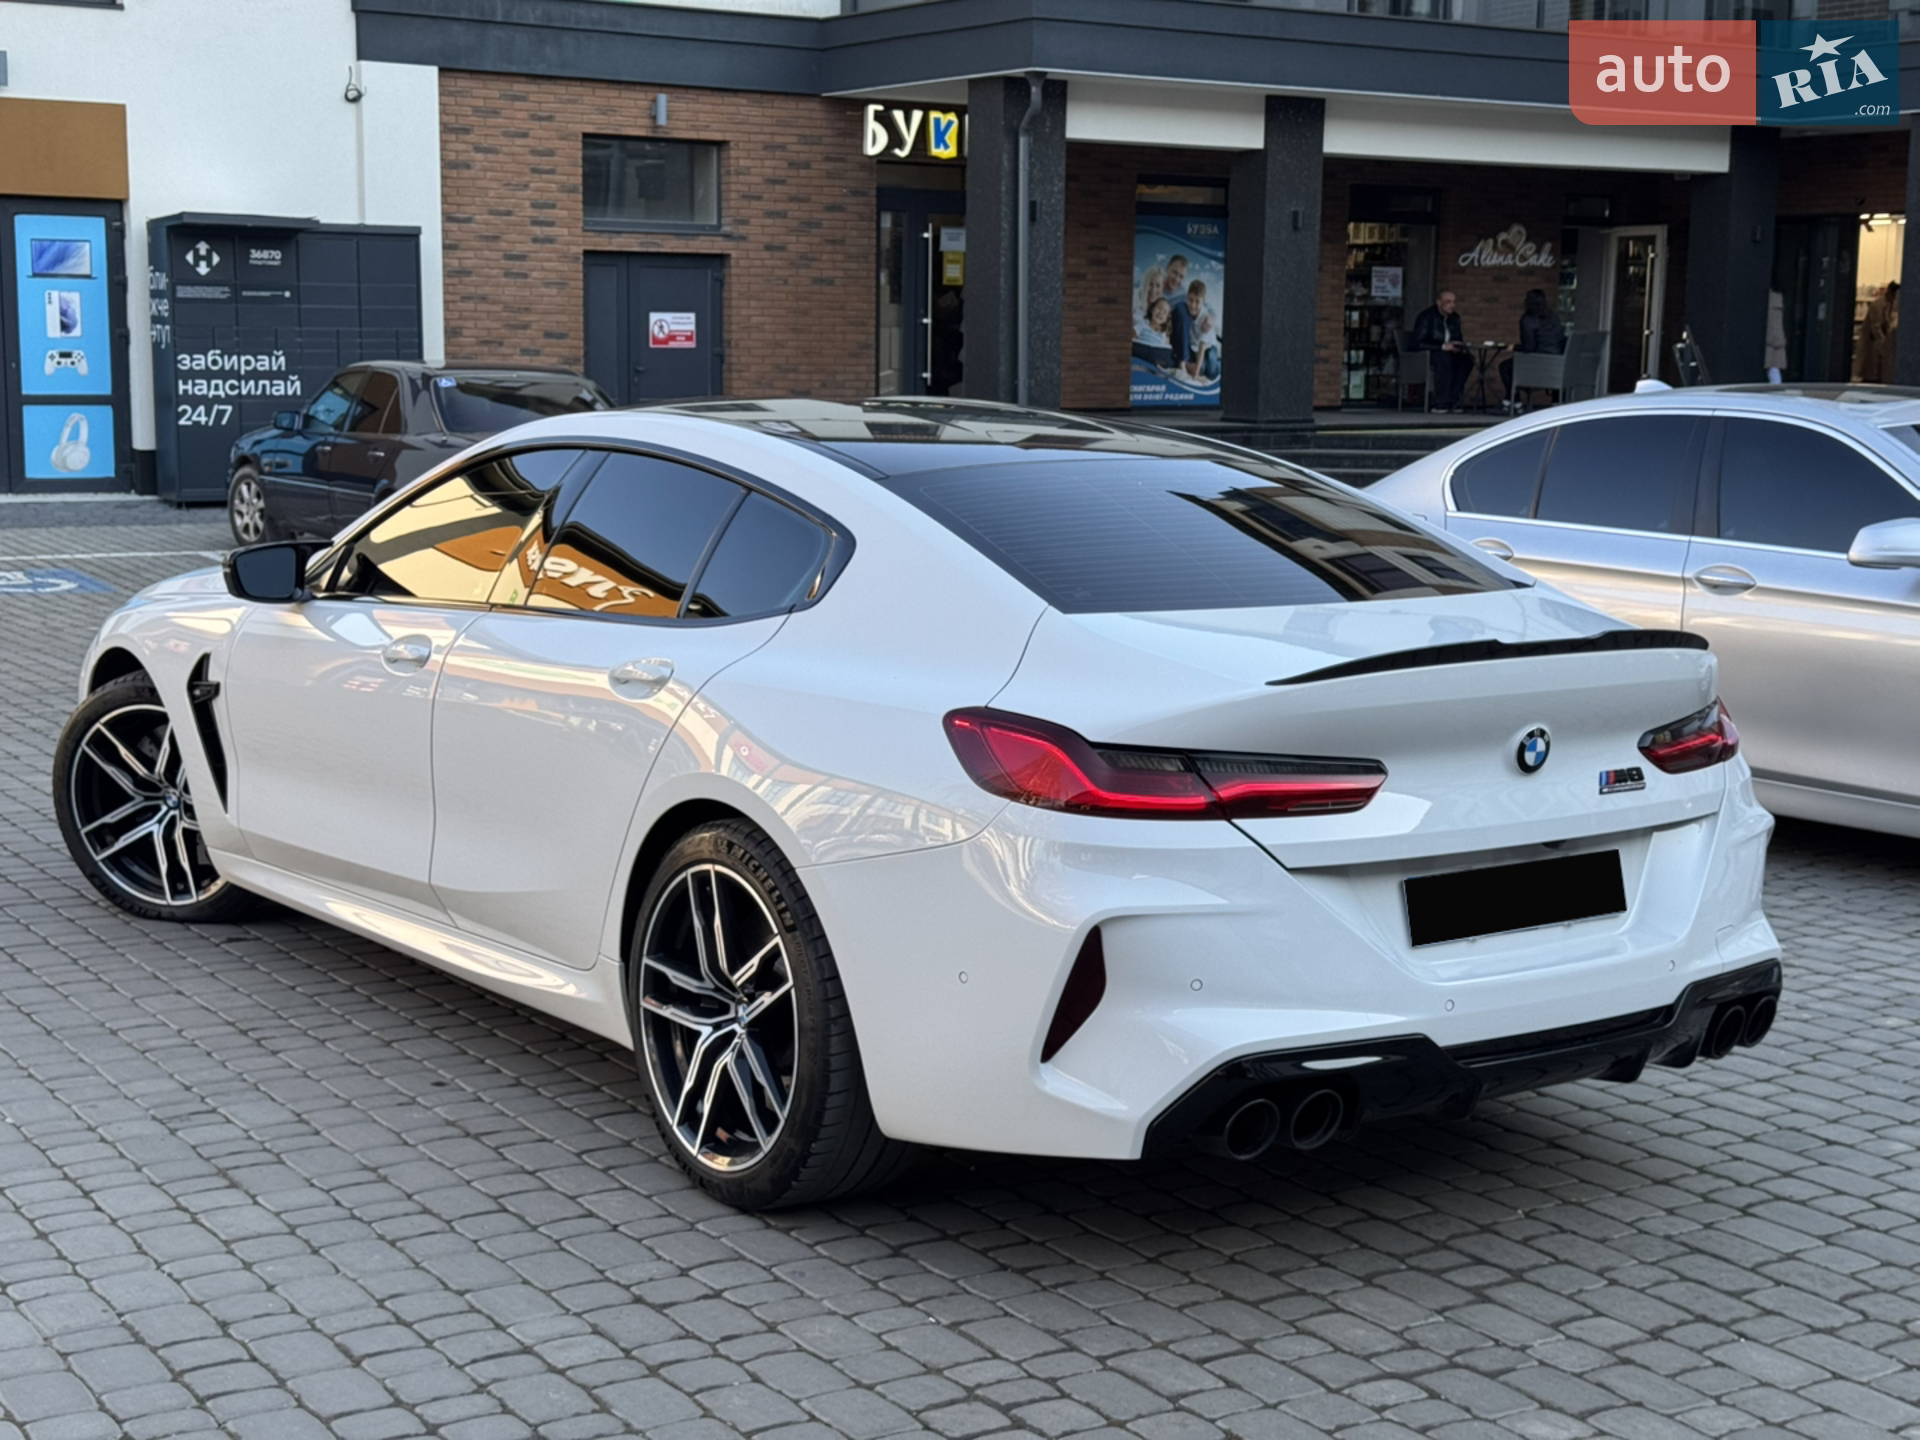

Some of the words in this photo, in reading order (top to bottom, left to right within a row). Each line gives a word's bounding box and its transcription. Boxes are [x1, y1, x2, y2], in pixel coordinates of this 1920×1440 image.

[863, 103, 968, 160] БУК
[249, 248, 282, 261] 36870
[177, 349, 286, 376] забирай
[178, 375, 301, 398] надсилай
[177, 404, 233, 426] 24/7
[730, 844, 797, 928] MICHELIN
